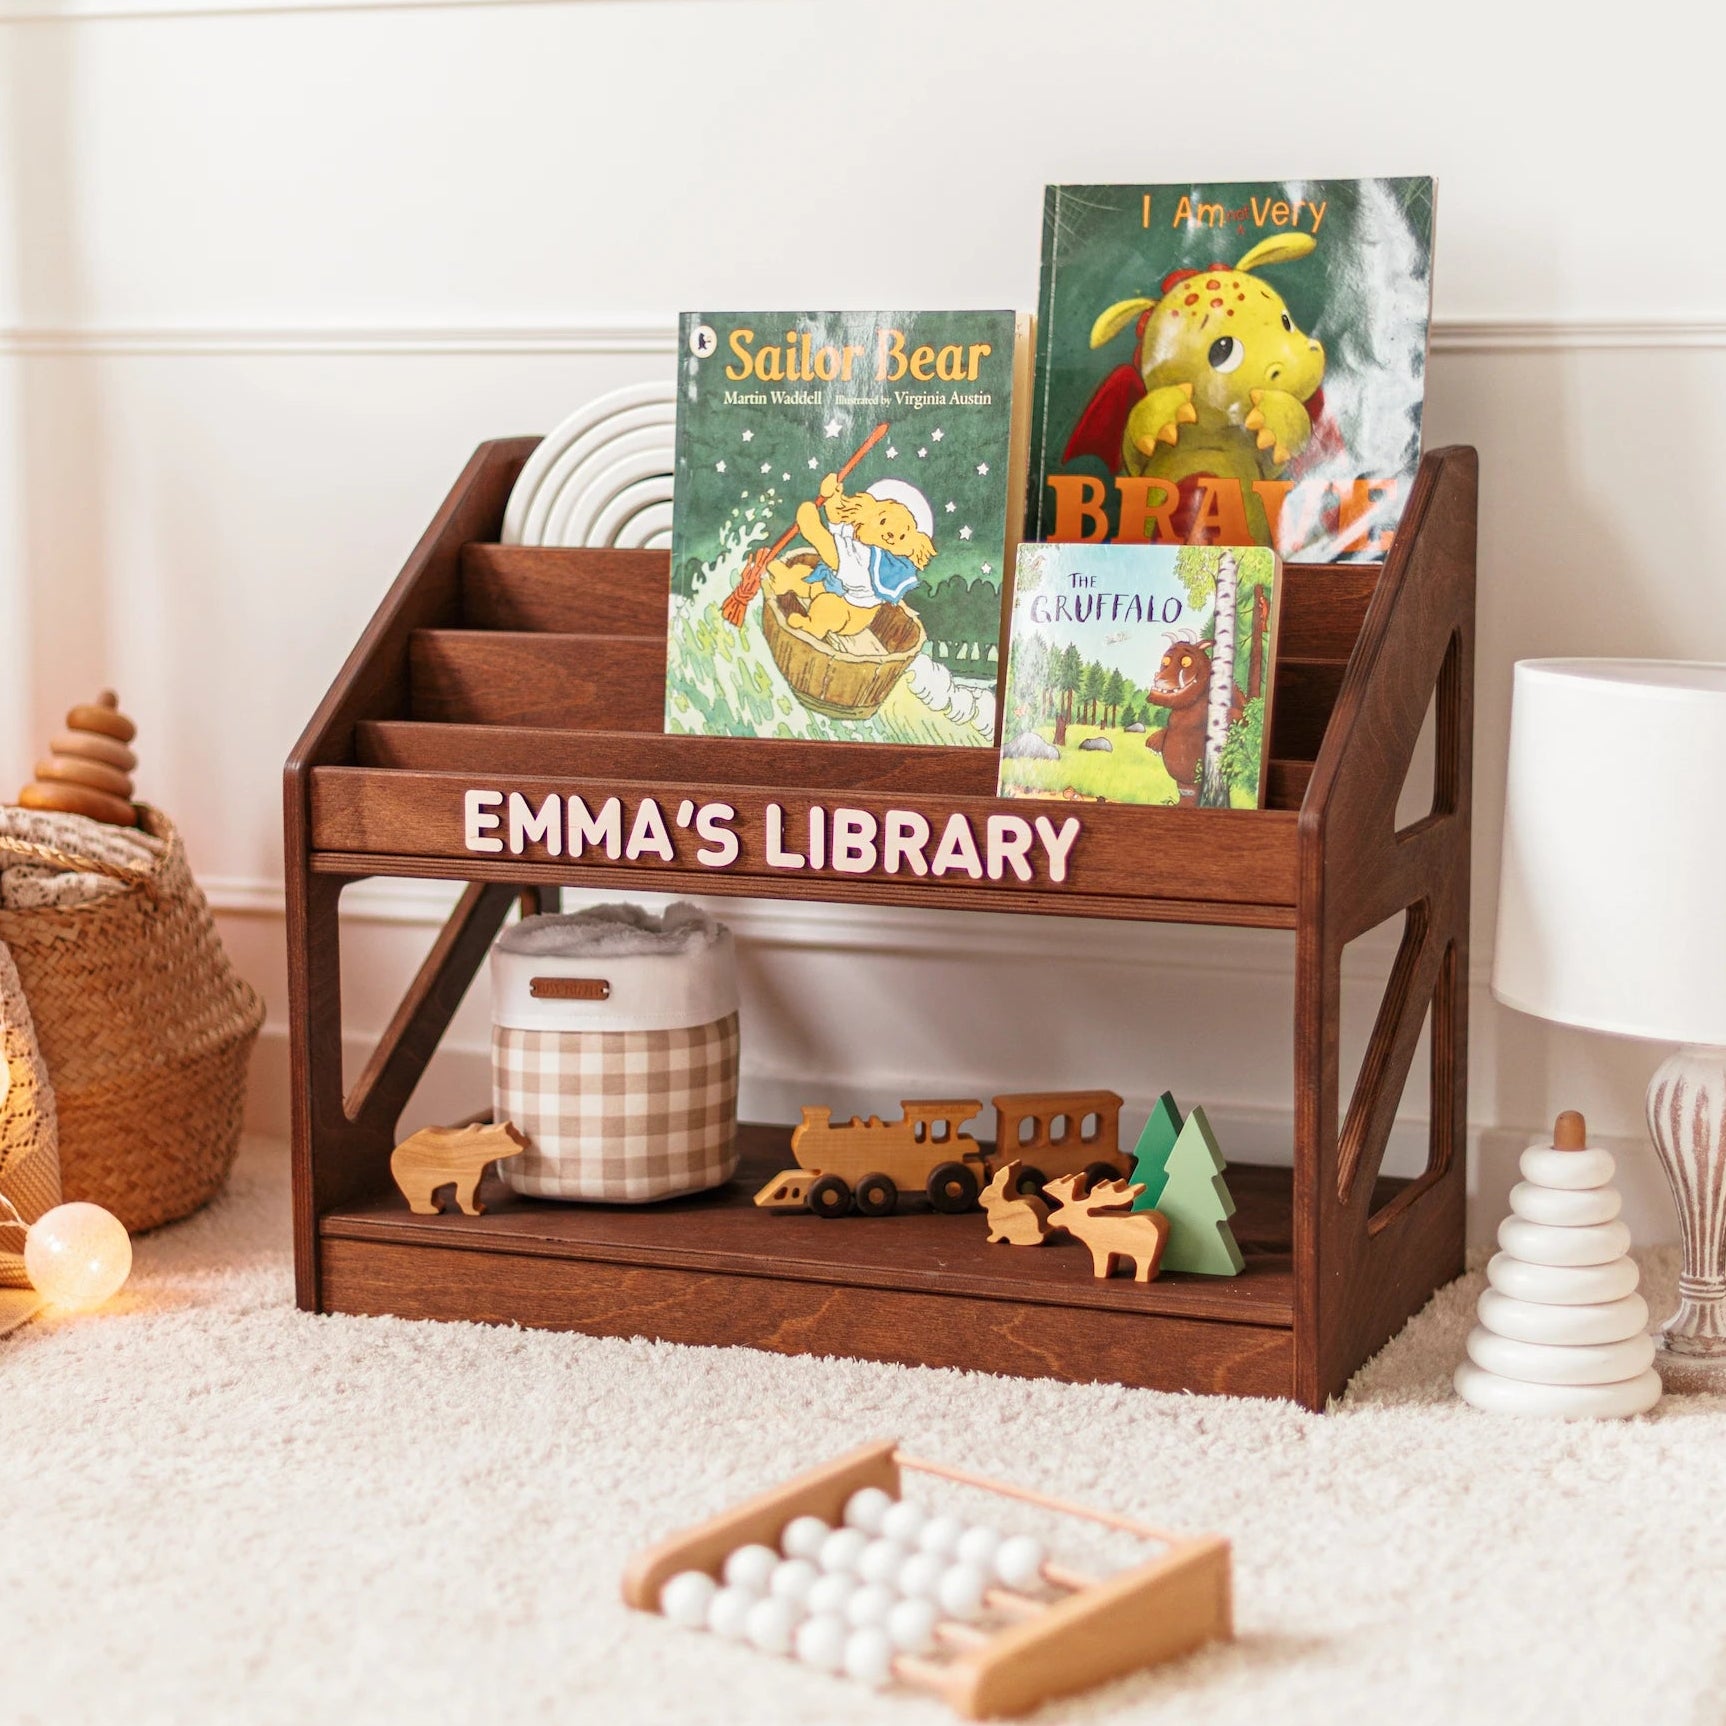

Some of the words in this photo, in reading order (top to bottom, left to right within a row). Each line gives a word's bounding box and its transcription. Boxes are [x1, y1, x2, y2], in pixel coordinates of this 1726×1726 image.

[1142, 193, 1151, 229] I
[1172, 195, 1225, 229] Am
[1250, 196, 1327, 234] Very
[725, 329, 865, 381] Sailor
[875, 329, 992, 381] Bear
[723, 391, 767, 405] Martin
[770, 391, 822, 405] Waddell
[880, 394, 892, 408] by
[894, 391, 946, 409] Virginia
[949, 391, 992, 405] Austin
[1068, 572, 1098, 588] THE
[1030, 593, 1183, 624] GRUFFALO
[464, 788, 740, 868] EMMA'S
[765, 803, 1082, 883] LIBRARY
